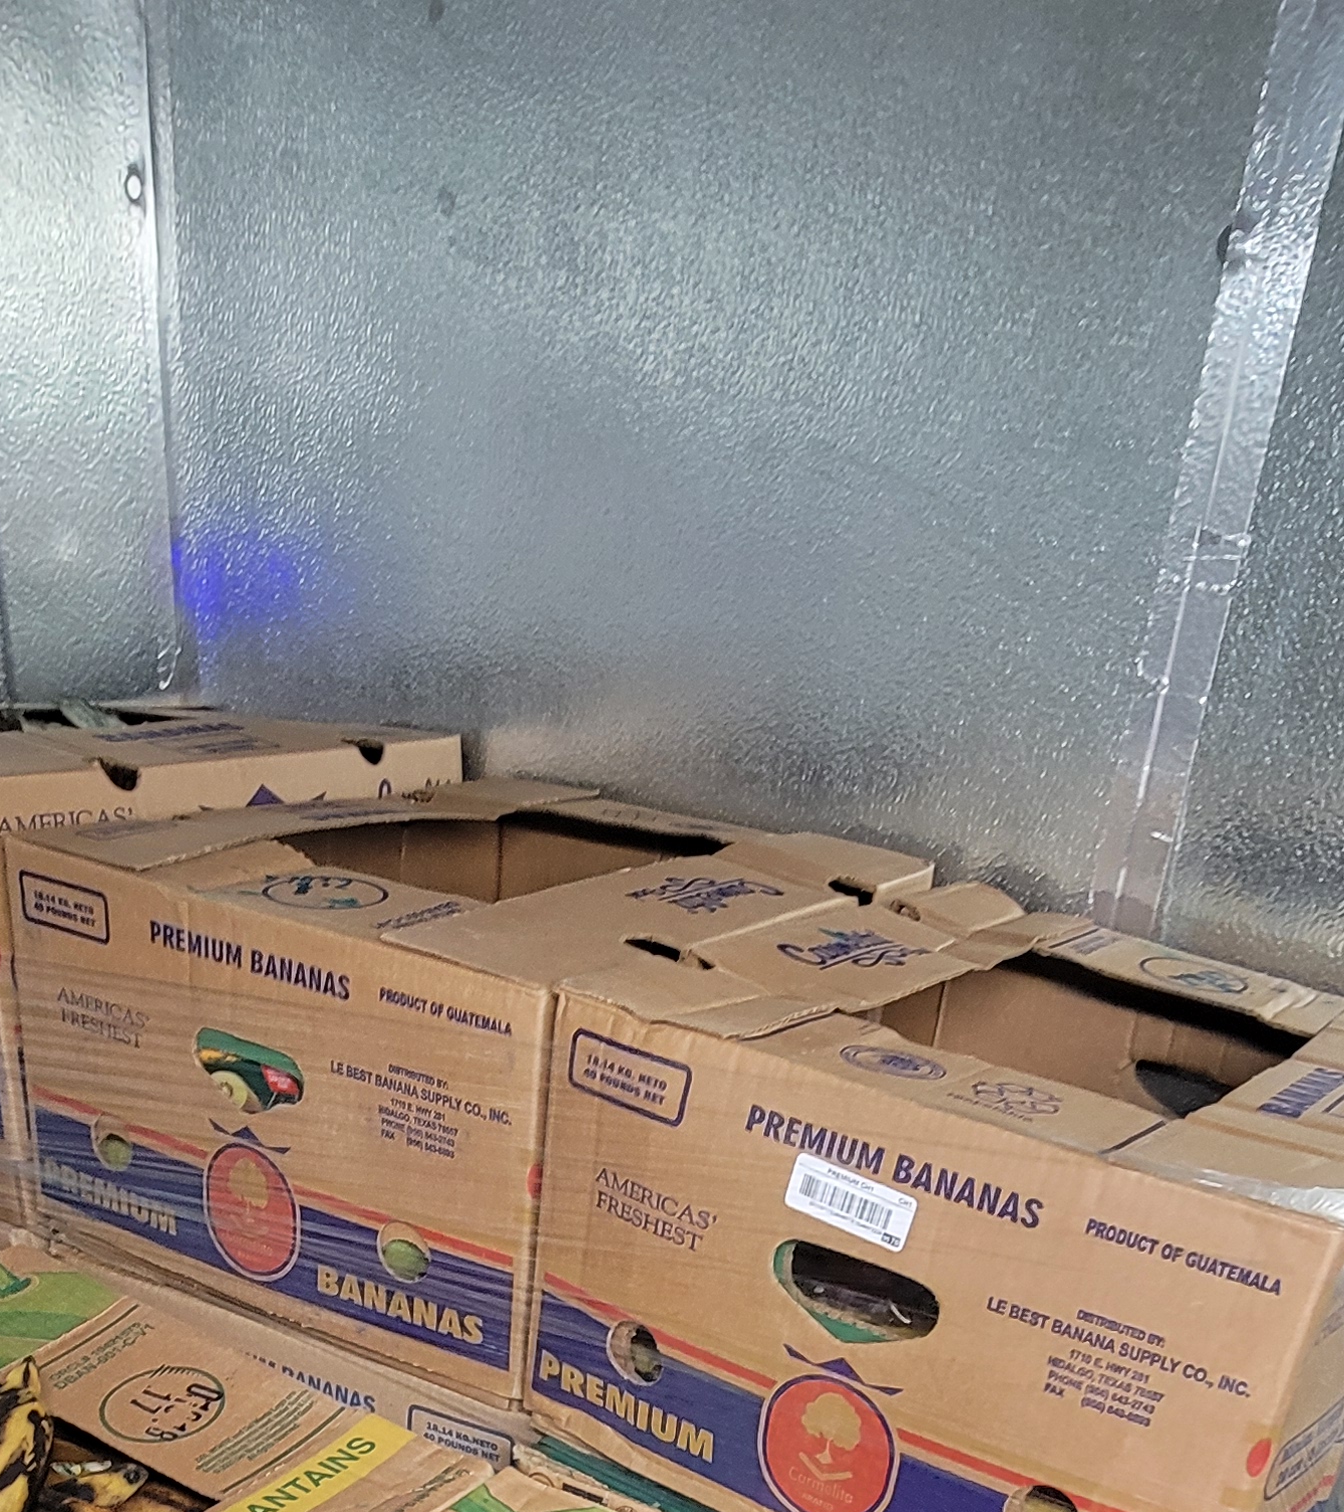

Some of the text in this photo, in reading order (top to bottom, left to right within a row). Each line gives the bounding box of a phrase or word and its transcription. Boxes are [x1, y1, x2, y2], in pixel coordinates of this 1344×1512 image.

[148, 920, 352, 1001] PREMIUM BANANAS
[57, 986, 151, 1029] AMERICAS'
[379, 987, 512, 1036] PRODUCT OF GUATEMALA
[330, 1060, 344, 1076] LE
[346, 1065, 372, 1084] BEST
[374, 1074, 419, 1100] BANANA
[420, 1089, 463, 1111] SUPPLY
[488, 1108, 512, 1126] INC.
[595, 1168, 717, 1232] AMERICAS'
[745, 1105, 886, 1175] PREMIUM
[893, 1154, 1044, 1230] BANANAS
[596, 1190, 704, 1252] FRESHEST
[1086, 1218, 1281, 1295] PRODUCT OF GUATEMALA
[316, 1262, 485, 1346] BANANAS
[986, 1296, 1251, 1398] LE BEST BANANA SUPPLY CO., INC.
[427, 1422, 453, 1436] 18.14
[539, 1350, 715, 1464] PREMIUM
[423, 1432, 500, 1462] 40 POUNDS NET
